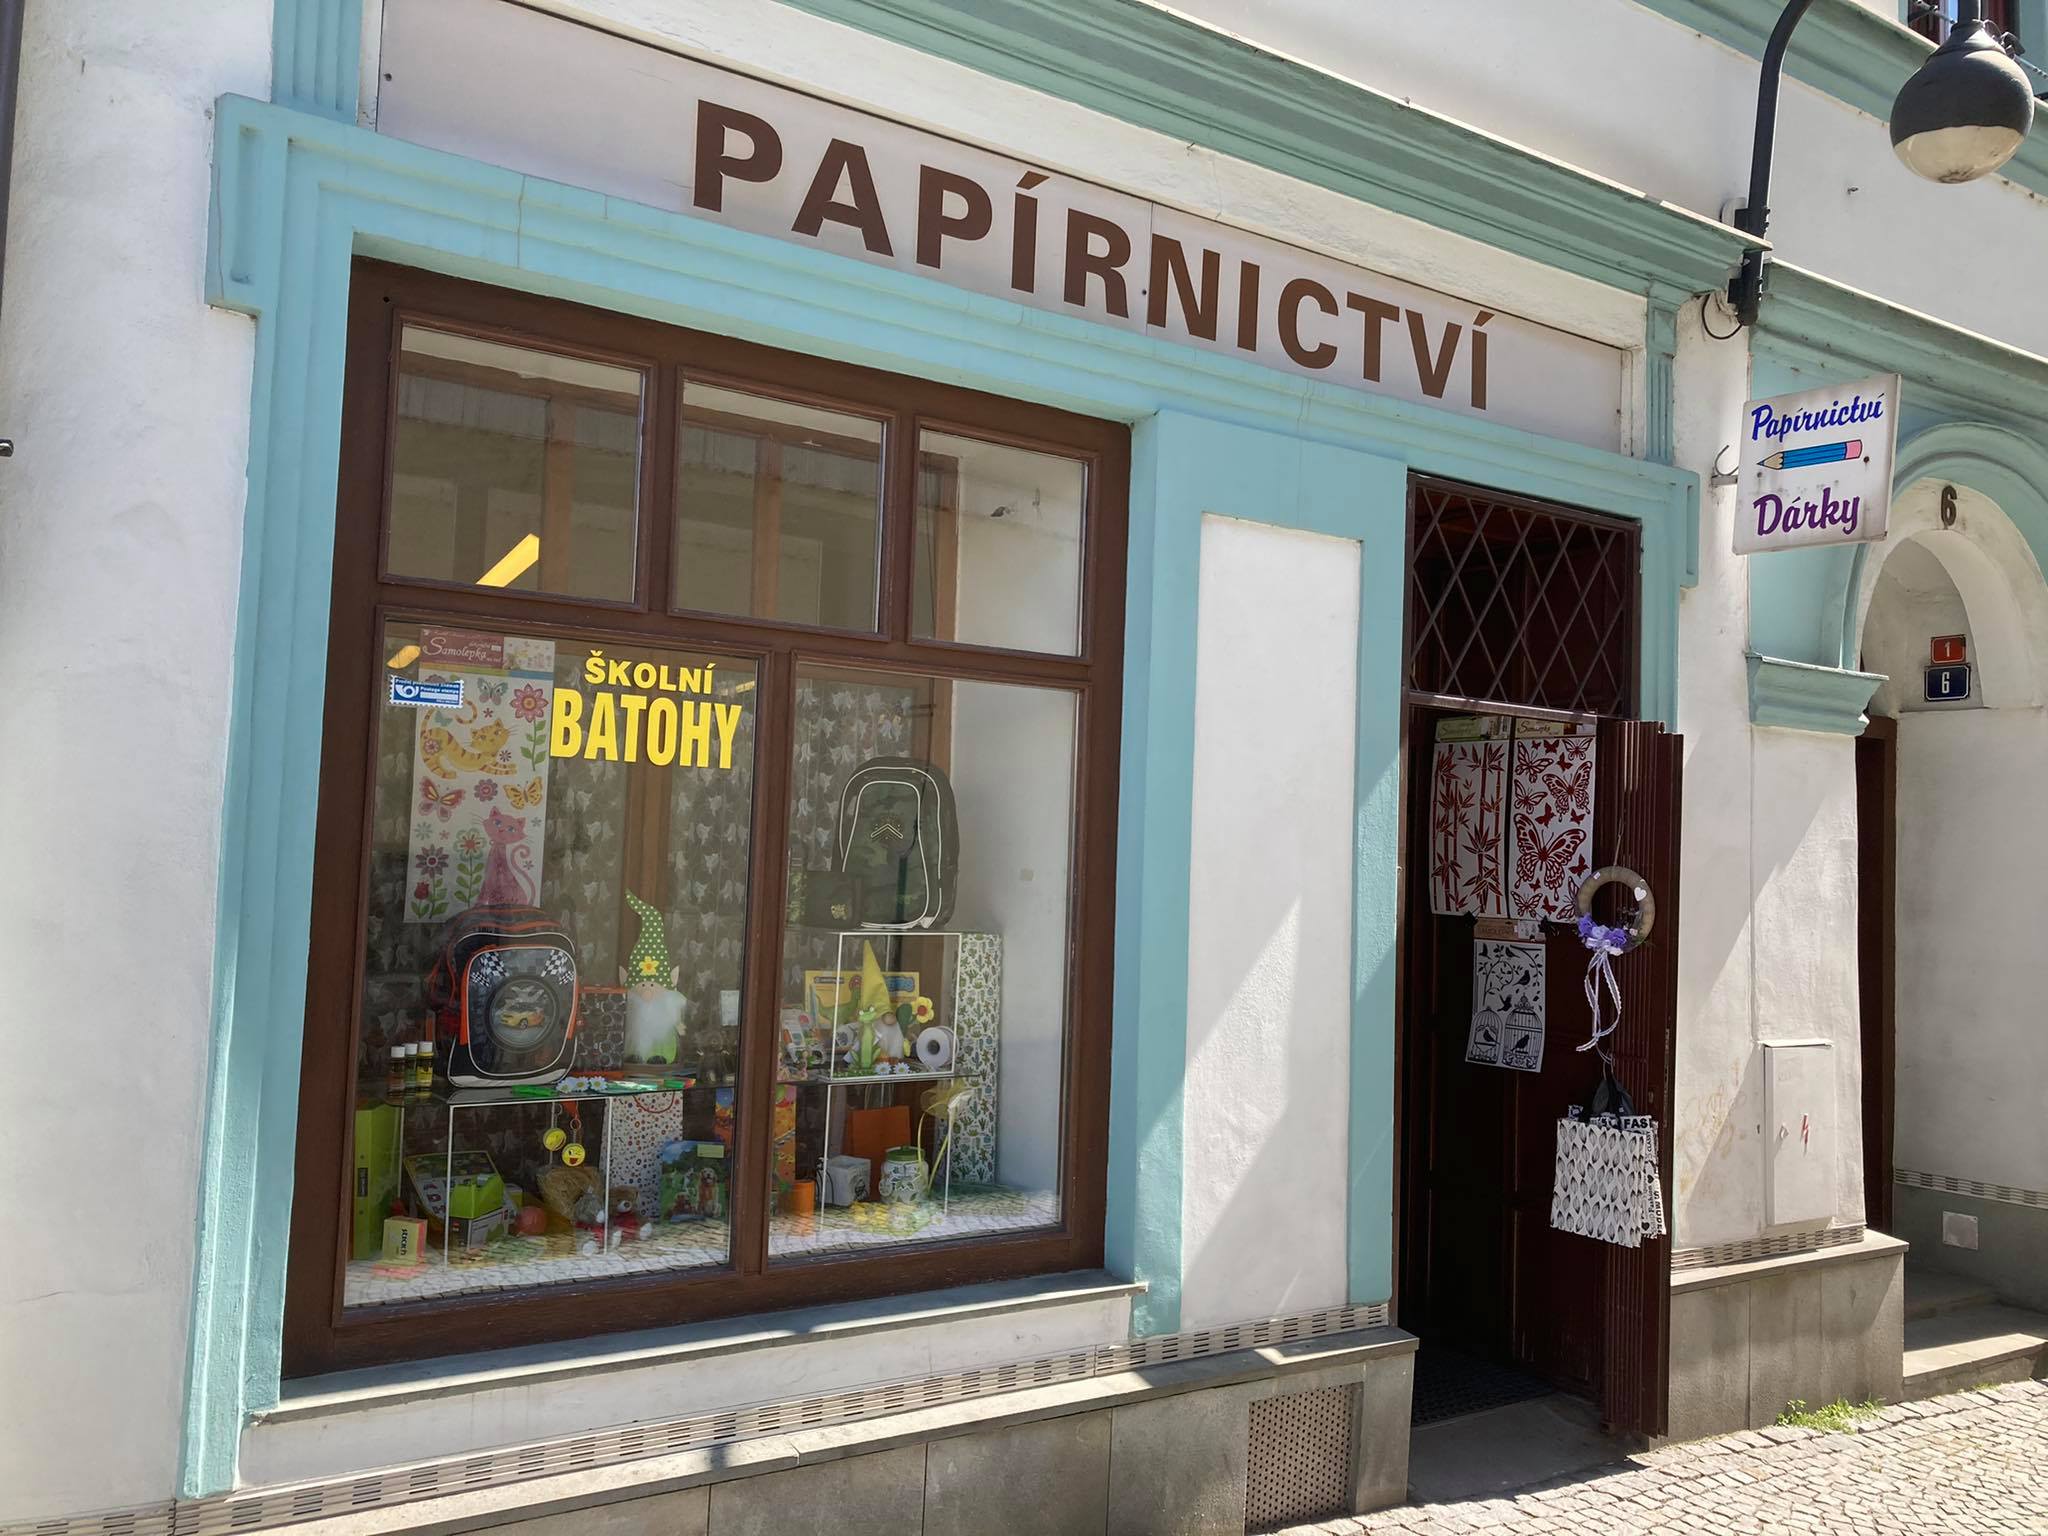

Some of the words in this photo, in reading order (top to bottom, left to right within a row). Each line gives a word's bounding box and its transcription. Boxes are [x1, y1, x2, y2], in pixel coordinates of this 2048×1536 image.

[693, 99, 1494, 411] PAPÍRNICTVÍ
[1751, 393, 1885, 443] Papírnictví
[1753, 487, 1860, 536] Dárky
[1940, 484, 1958, 527] 6
[422, 636, 487, 661] Samolepka
[1944, 641, 1950, 657] 1
[584, 649, 716, 695] ŠKOLNÍ
[1941, 671, 1950, 694] 6
[550, 687, 742, 769] BATOHY
